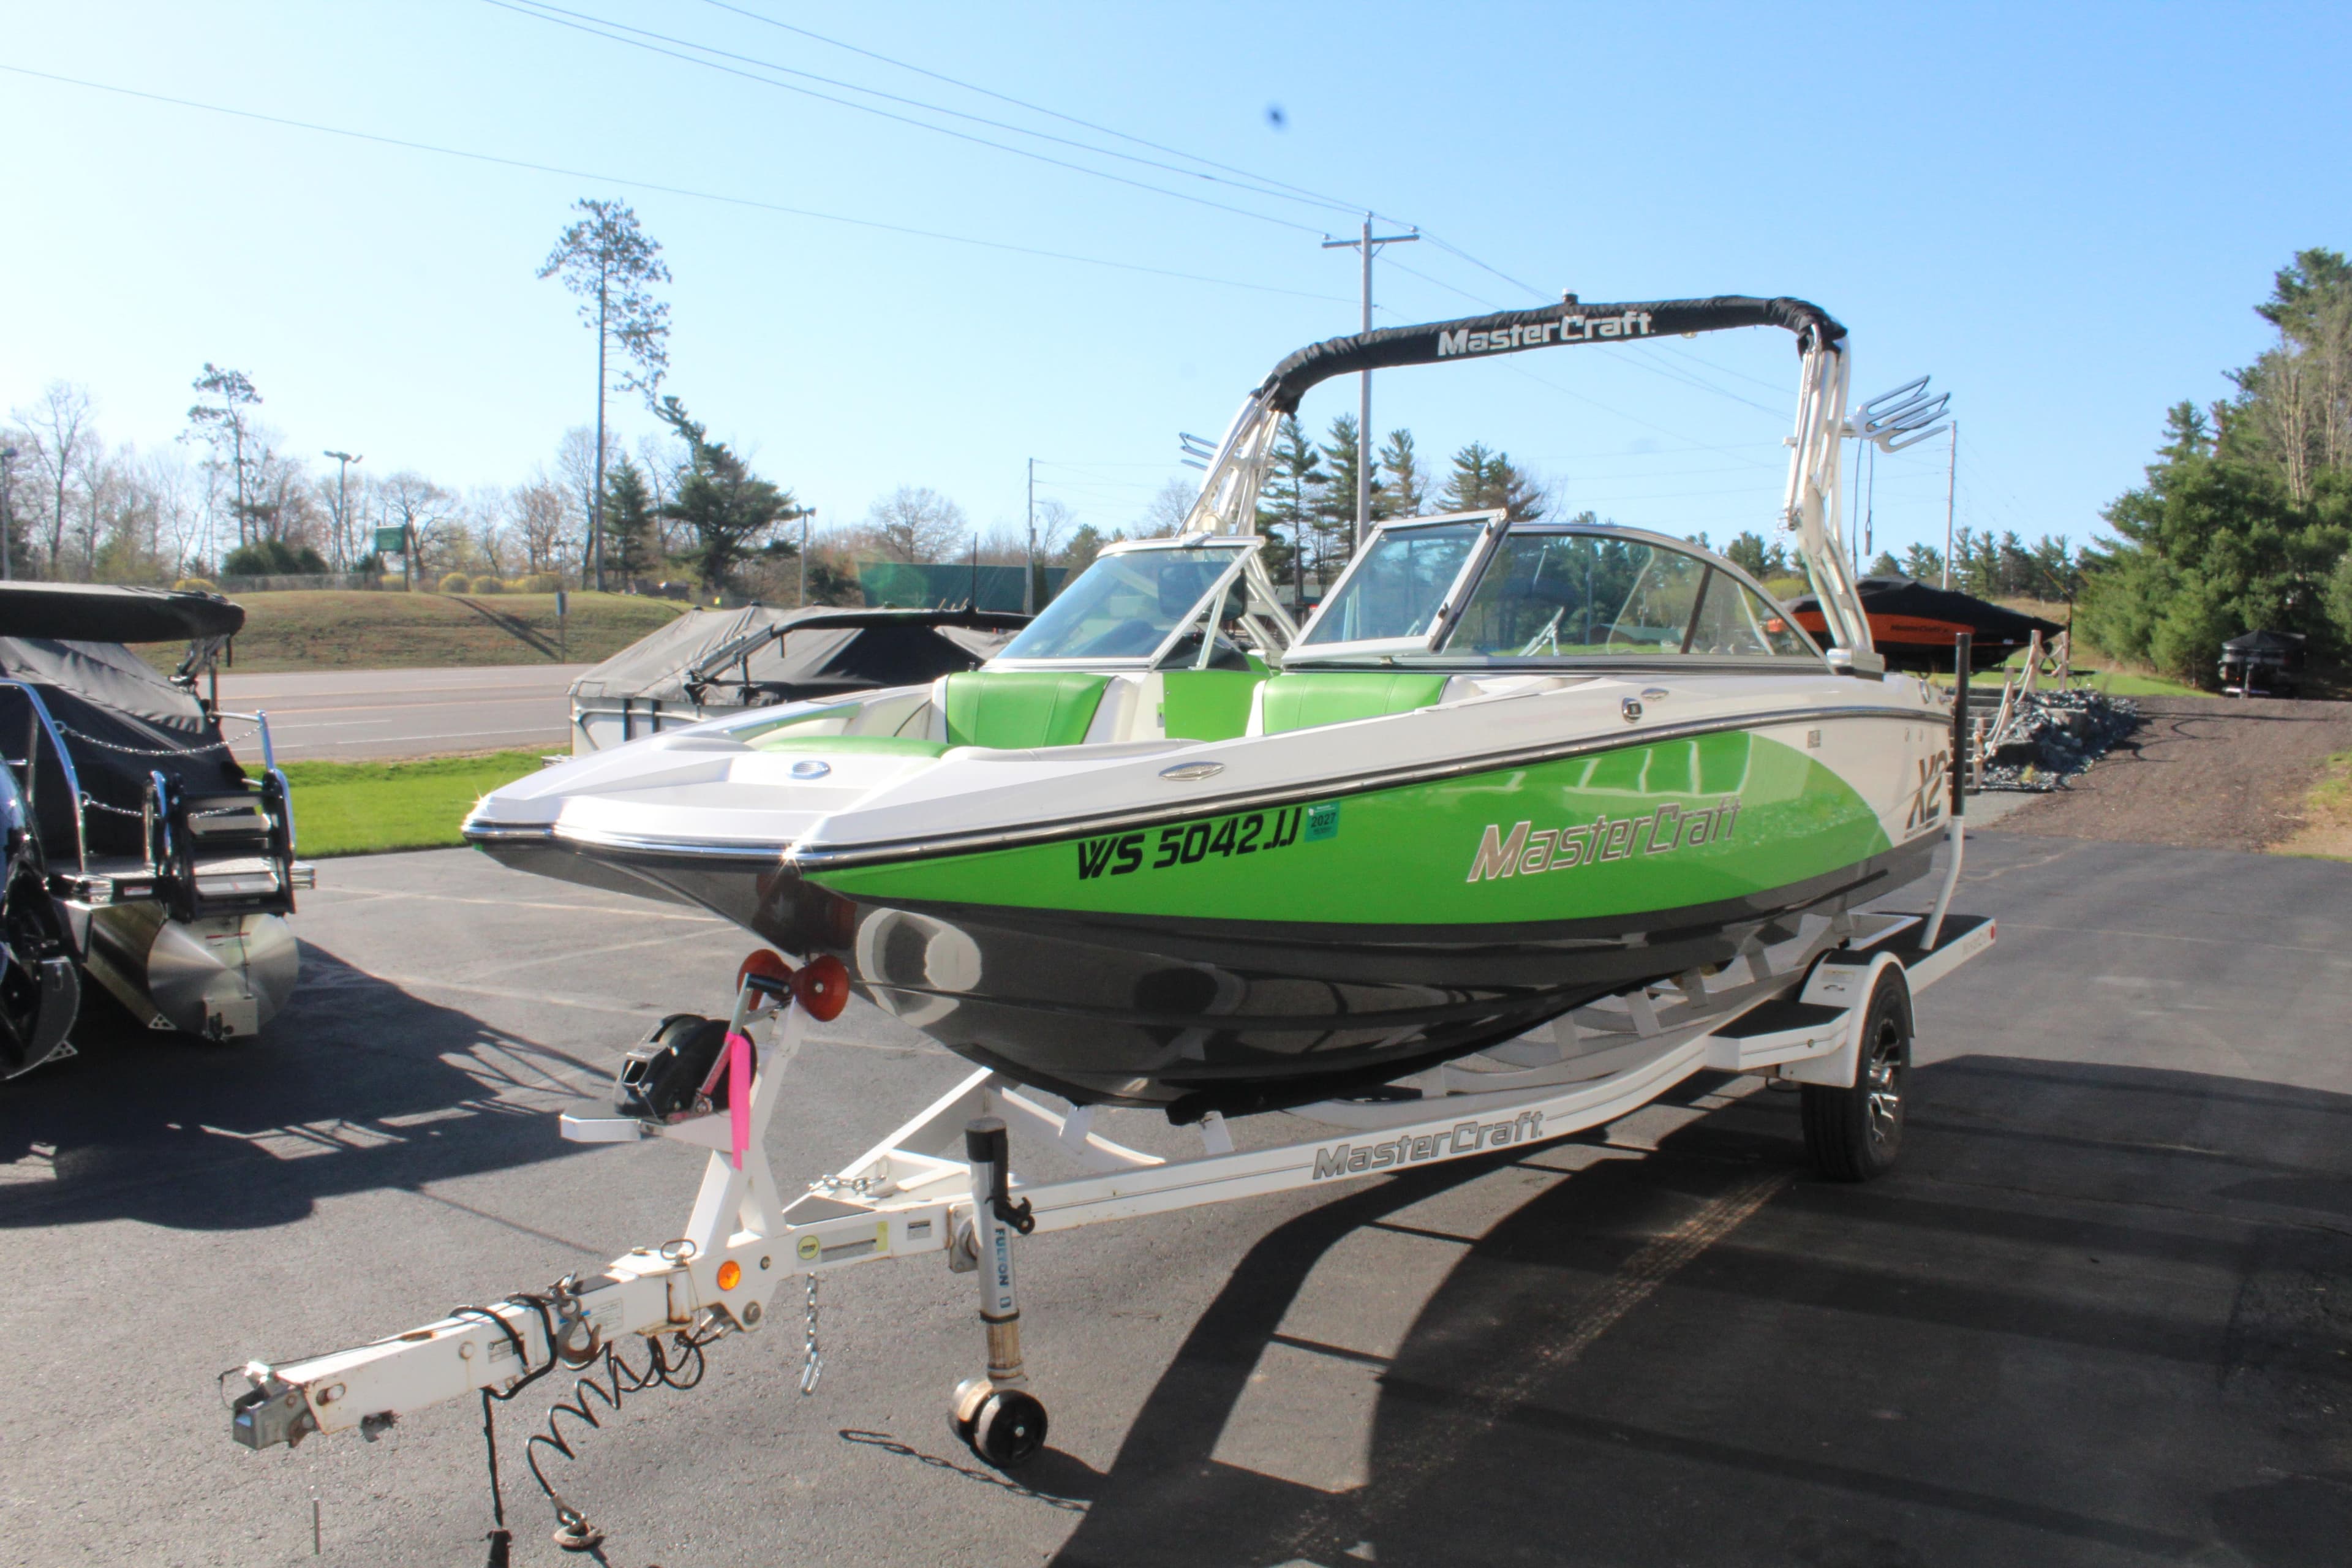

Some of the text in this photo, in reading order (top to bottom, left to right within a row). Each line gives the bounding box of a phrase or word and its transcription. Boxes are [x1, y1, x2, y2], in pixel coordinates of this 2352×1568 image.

[1437, 310, 1652, 356] MasterCraft
[1077, 833, 1145, 880] WS
[1466, 796, 1742, 883] MasterCraft
[1312, 1110, 1544, 1180] MasterCraft
